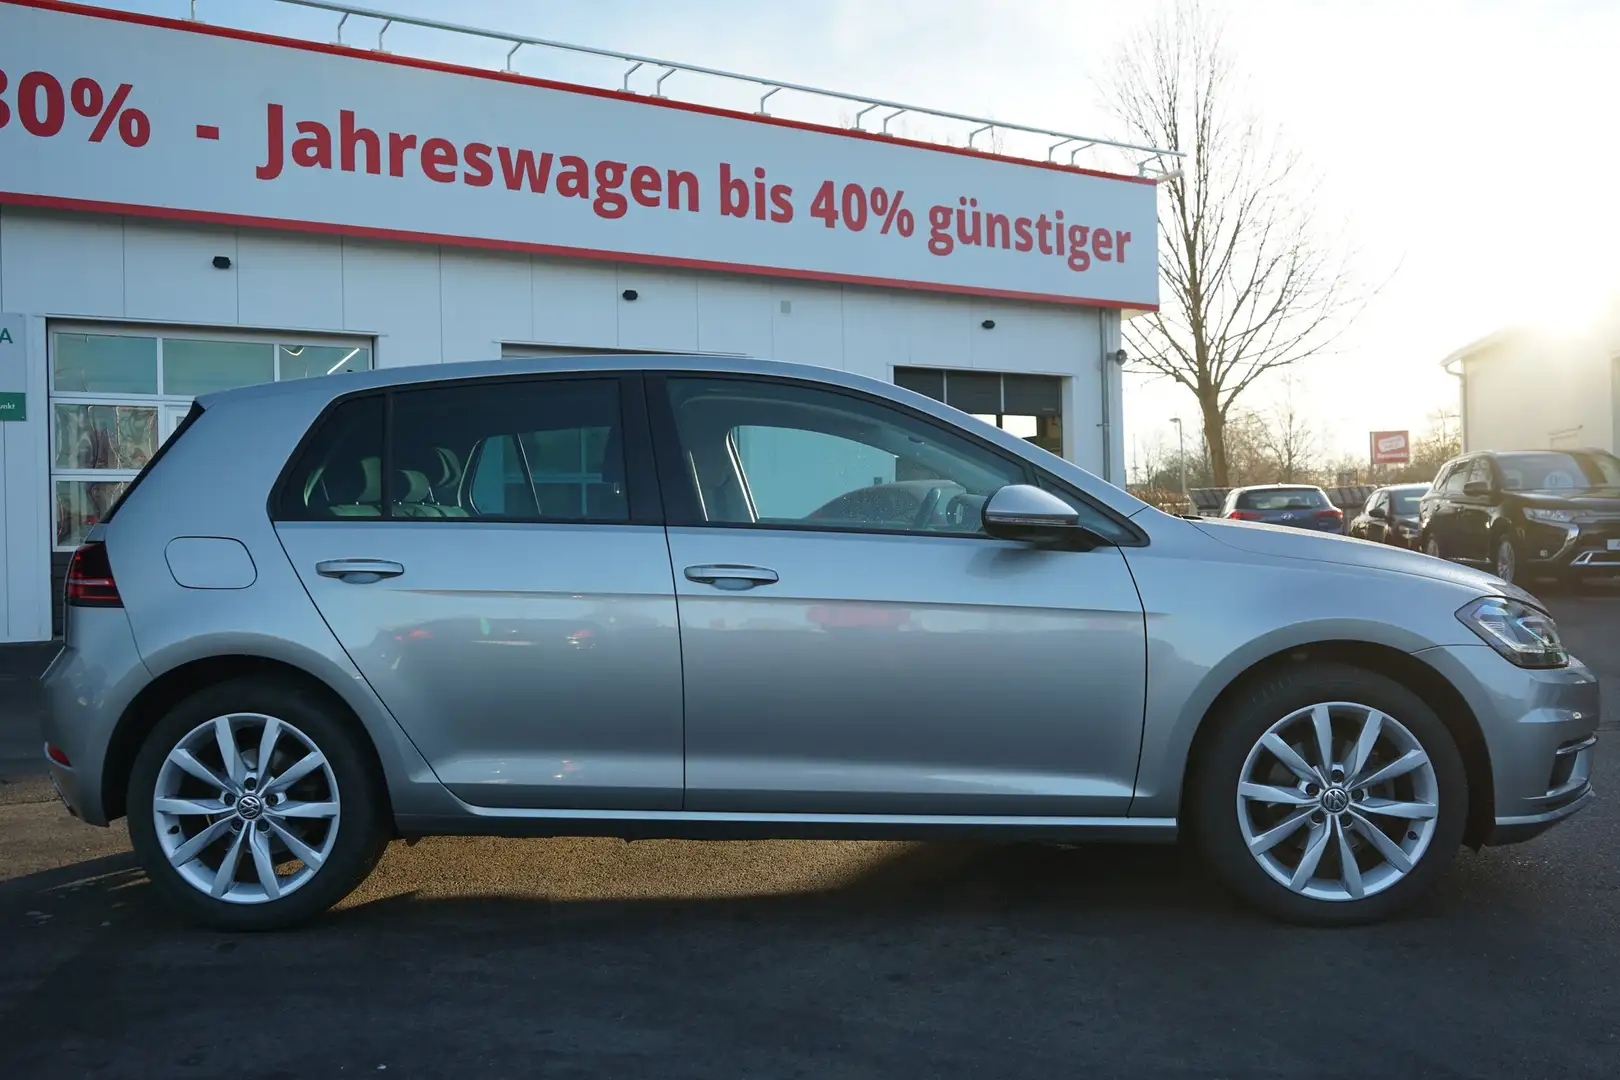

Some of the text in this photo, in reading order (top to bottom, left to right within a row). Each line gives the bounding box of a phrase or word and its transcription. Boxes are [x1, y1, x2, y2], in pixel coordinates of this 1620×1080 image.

[0, 69, 151, 148] 0%
[256, 103, 698, 219] Jahreswagen
[719, 162, 794, 224] bis
[810, 180, 915, 238] 40%
[927, 196, 1132, 272] günstiger
